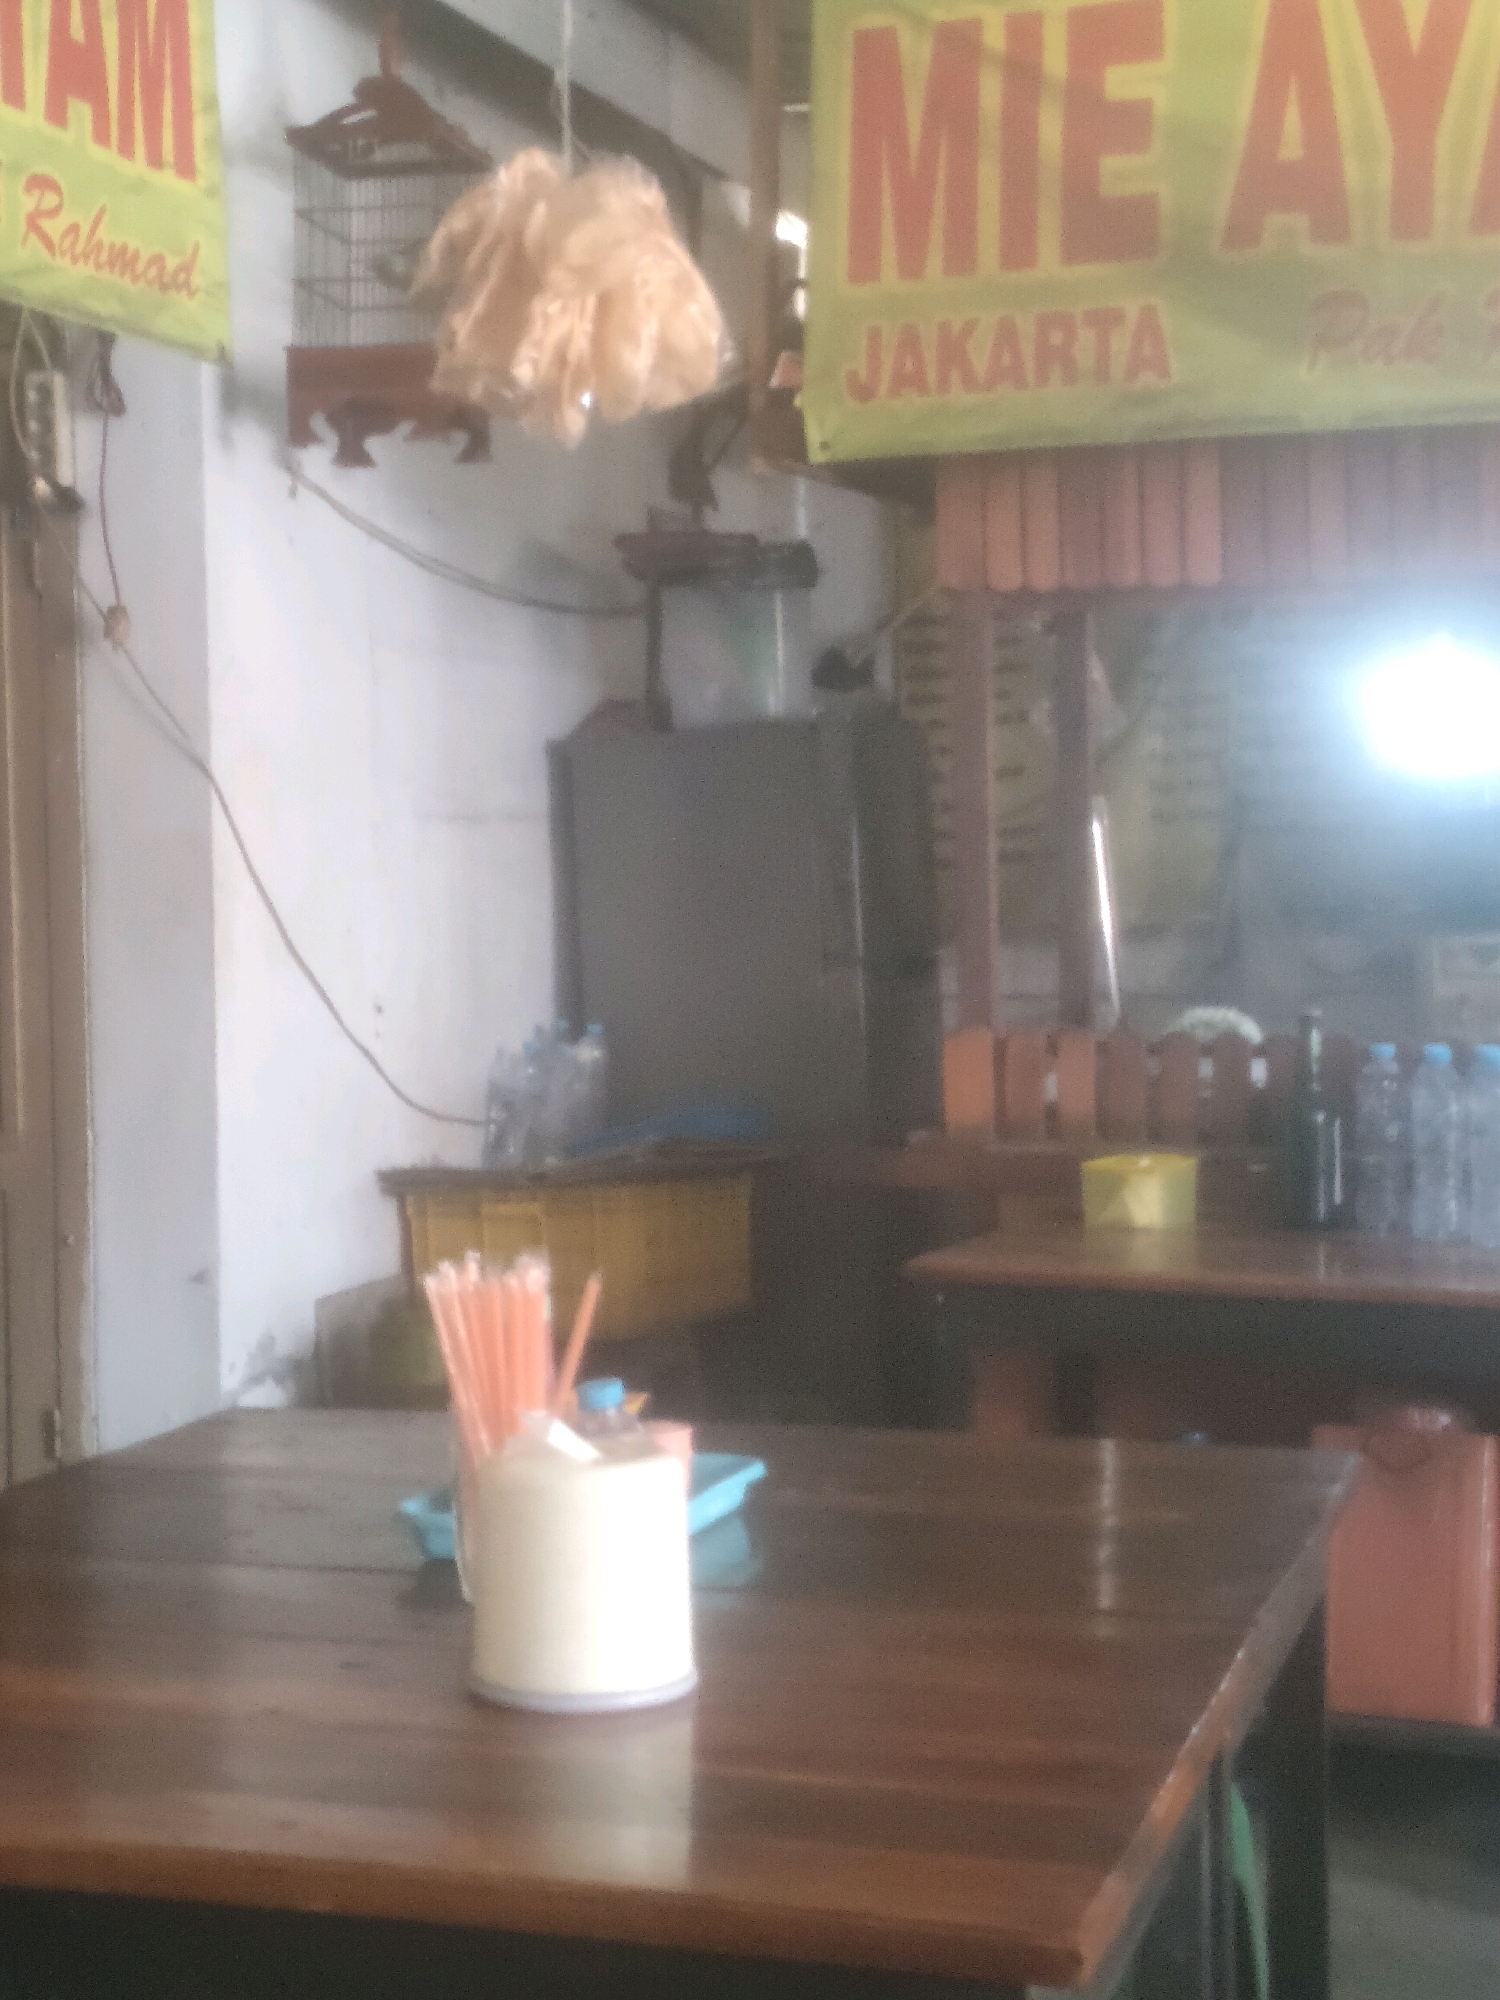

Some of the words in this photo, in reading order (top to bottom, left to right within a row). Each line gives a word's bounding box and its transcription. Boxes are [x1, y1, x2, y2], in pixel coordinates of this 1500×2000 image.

[846, 0, 1163, 284] MIE
[21, 173, 200, 299] Rahmad
[845, 304, 1171, 402] JAKARTA
[1306, 289, 1447, 370] Pak
